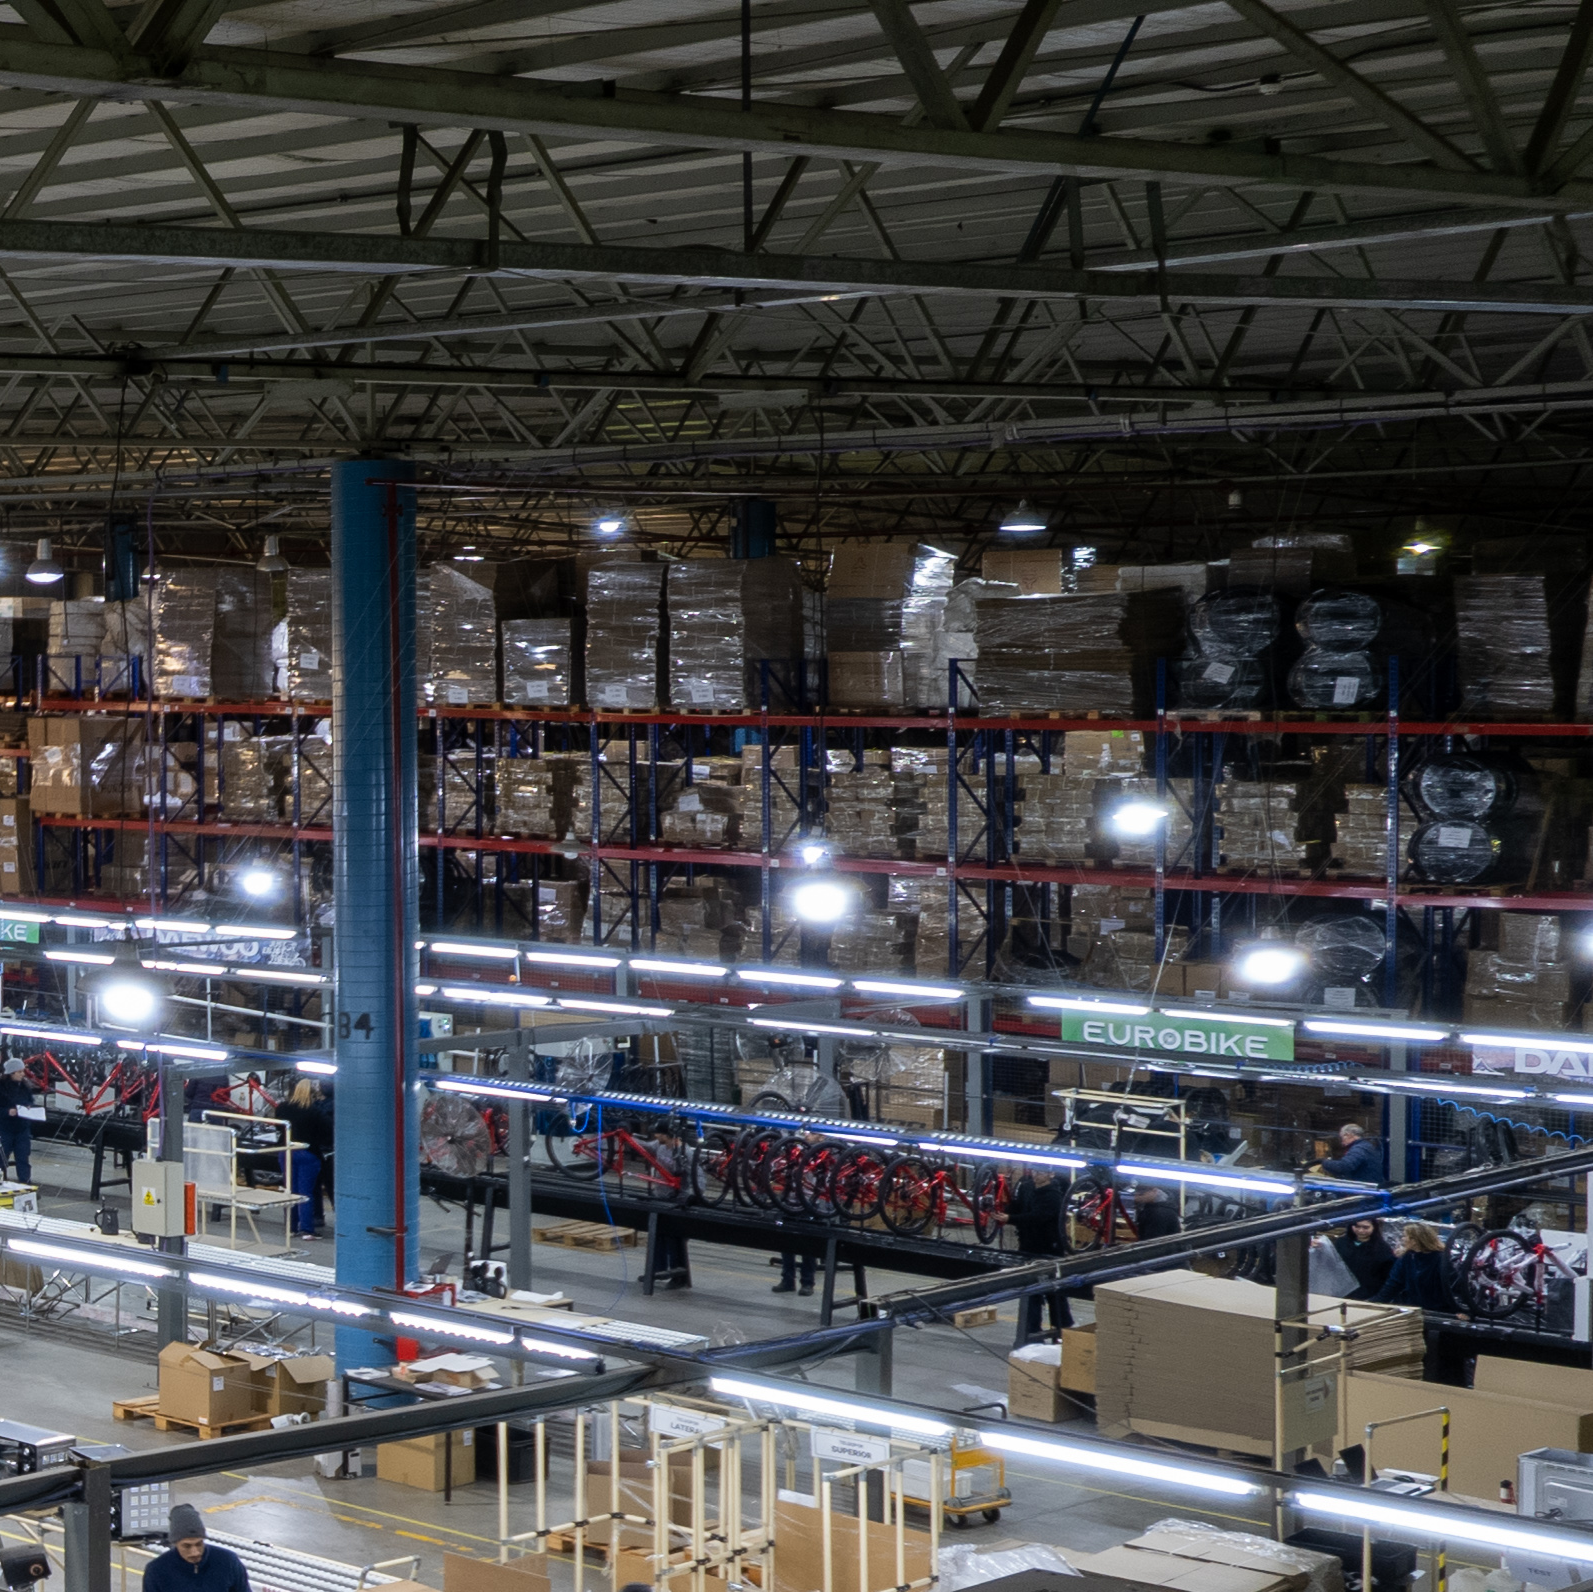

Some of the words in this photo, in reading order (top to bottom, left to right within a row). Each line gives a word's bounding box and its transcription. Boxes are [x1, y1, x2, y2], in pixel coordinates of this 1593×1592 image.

[338, 1012, 375, 1040] B4
[1082, 1019, 1271, 1058] EUROBIKE
[831, 1446, 873, 1459] SUPERIOR
[1527, 1567, 1551, 1577] TEST
